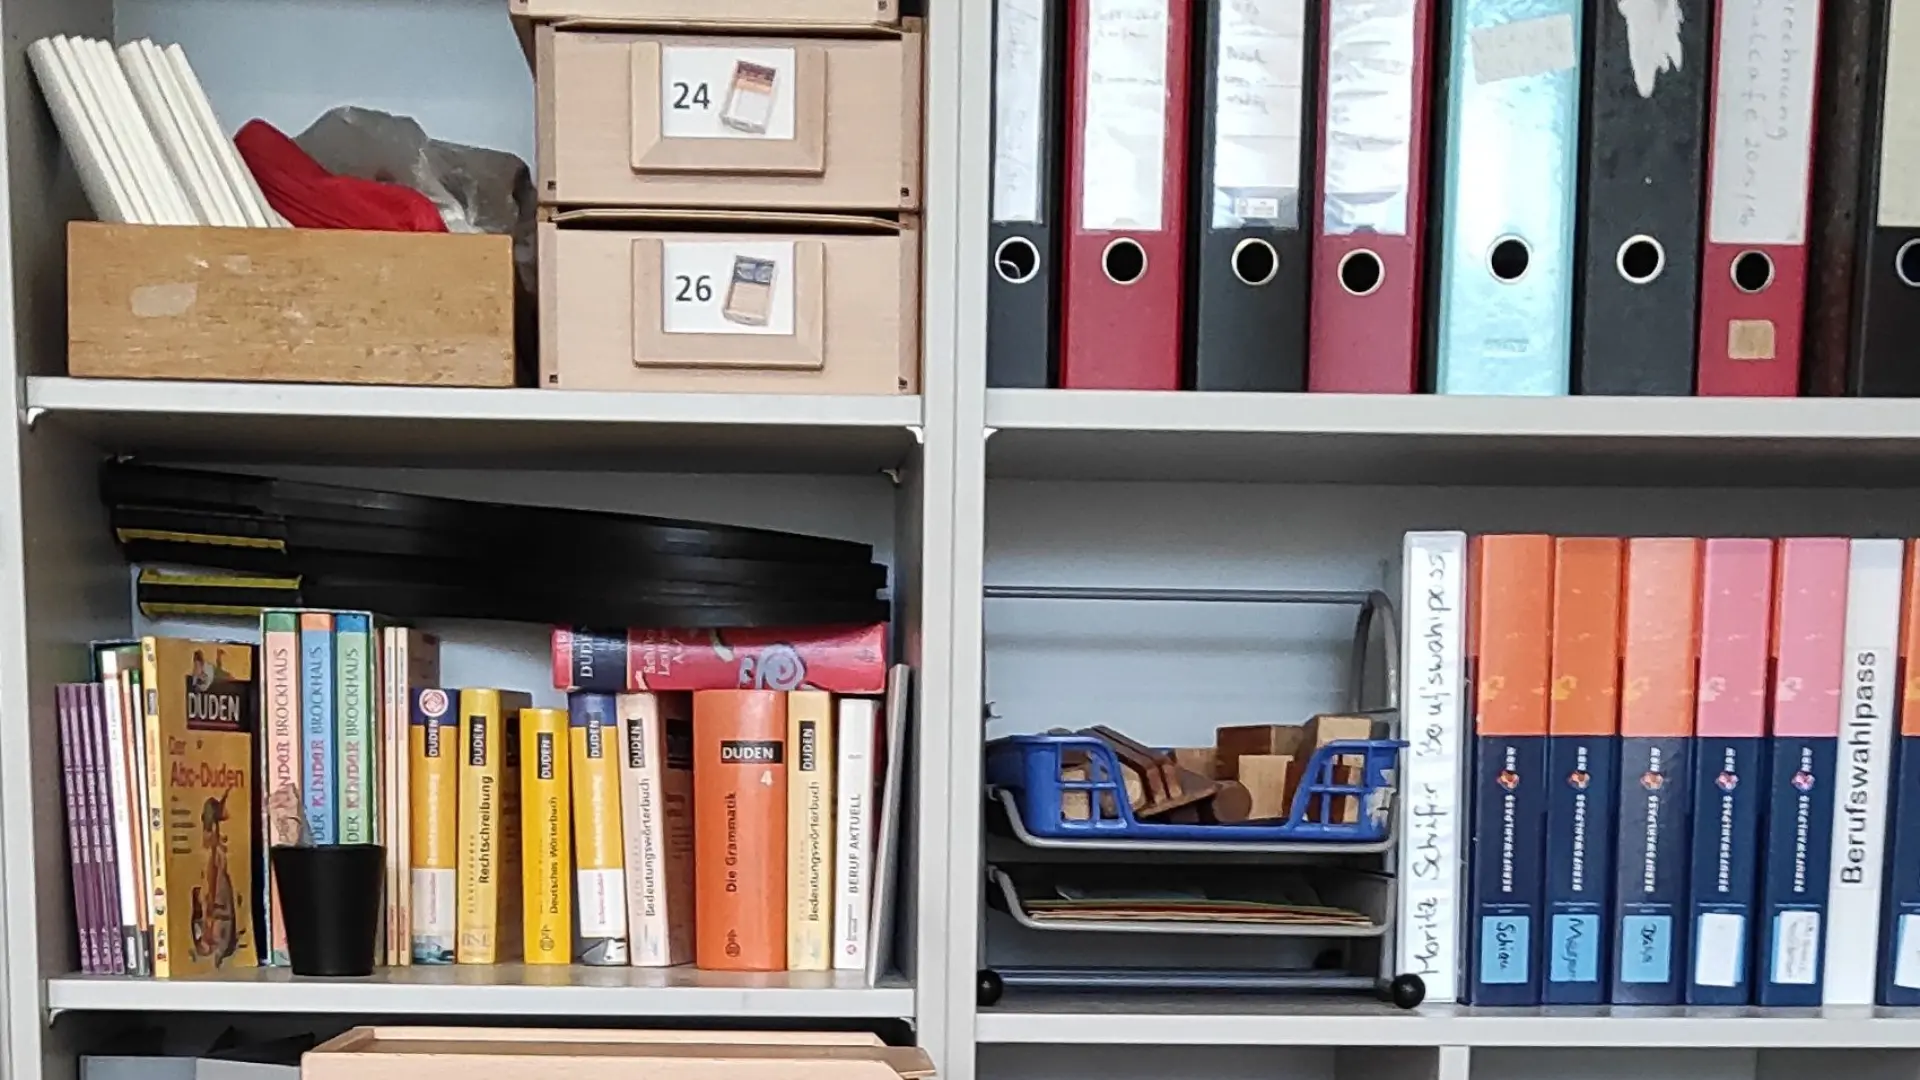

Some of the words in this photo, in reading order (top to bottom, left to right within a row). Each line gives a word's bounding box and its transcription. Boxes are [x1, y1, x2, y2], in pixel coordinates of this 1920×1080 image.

[672, 82, 711, 109] 24
[675, 275, 712, 301] 26
[188, 692, 240, 722] DUDEN
[273, 648, 289, 737] BROCKHAUS
[309, 647, 323, 735] BROCKHAUS
[345, 648, 360, 737] BROCKHAUS
[428, 719, 439, 756] DUDEN
[472, 723, 485, 765] DUDEN
[589, 719, 600, 757] DUDEN
[630, 726, 642, 767] DUDEN
[722, 746, 774, 760] DUDEN
[802, 728, 814, 770] DUDEN
[170, 760, 245, 789] Abc-Duden
[540, 739, 552, 778] DUDEN
[760, 770, 774, 786] 4
[1841, 651, 1876, 885] Berufswahlpass
[311, 814, 325, 841] DER
[346, 815, 360, 842] DER
[479, 775, 495, 884] Rechtschreibung
[547, 796, 559, 858] Wörterbuch
[724, 791, 738, 867] Grammatik
[848, 793, 862, 850] AKTUELL
[638, 778, 657, 917] Bedeutungswörterbuch
[807, 781, 822, 922] Bedeutungswörterbuch
[549, 860, 559, 914] Deutsches
[725, 870, 738, 893] Die
[848, 853, 860, 894] BERUF
